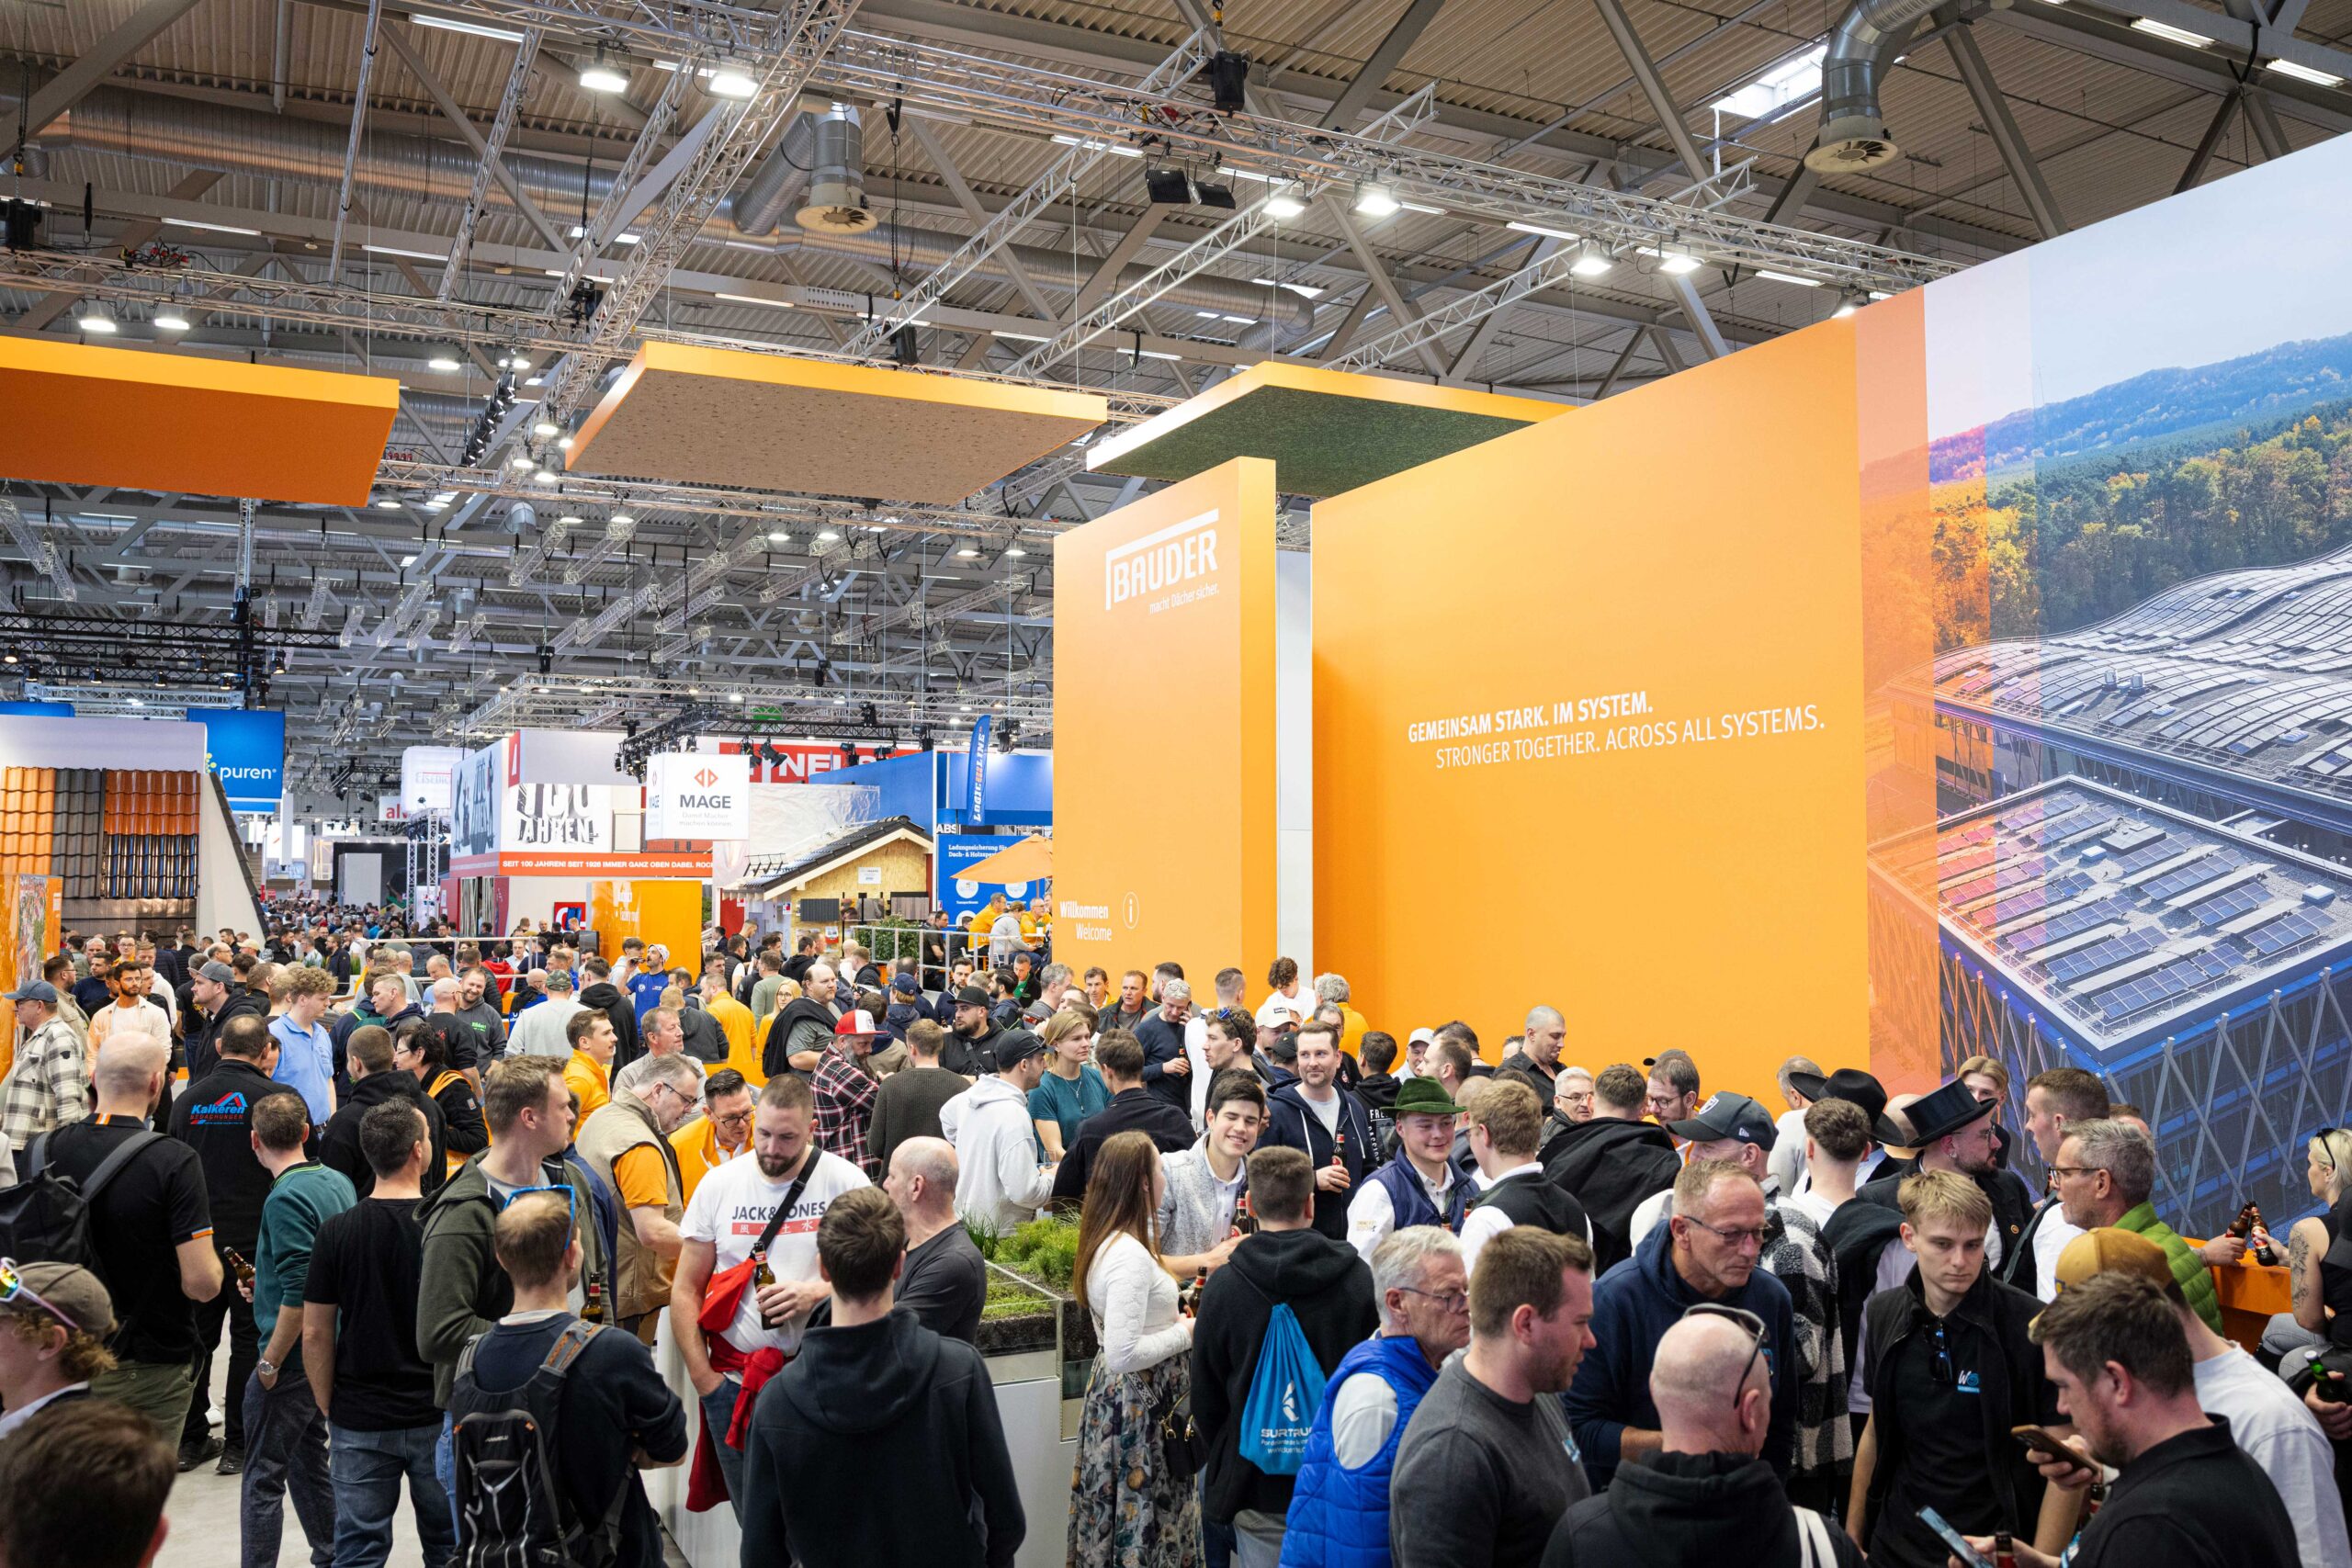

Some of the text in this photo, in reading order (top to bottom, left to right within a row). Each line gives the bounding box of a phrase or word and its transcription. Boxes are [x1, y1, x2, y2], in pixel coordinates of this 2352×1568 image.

[1114, 528, 1217, 604] BAUDER
[1149, 597, 1170, 614] macht
[1171, 590, 1195, 607] Dächer
[1408, 690, 1654, 743] GEMEINSAM STARK. IM SYSTEM.
[1436, 704, 1826, 769] STRONGER TOGETHER. ACROSS ALL SYSTEMS.
[679, 794, 732, 809] MAGE
[936, 823, 956, 834] ABS
[1059, 900, 1109, 919] Willkommen
[1075, 922, 1113, 942] Welcome
[191, 1104, 245, 1114] Kalkeren
[1369, 1108, 1389, 1119] FRE
